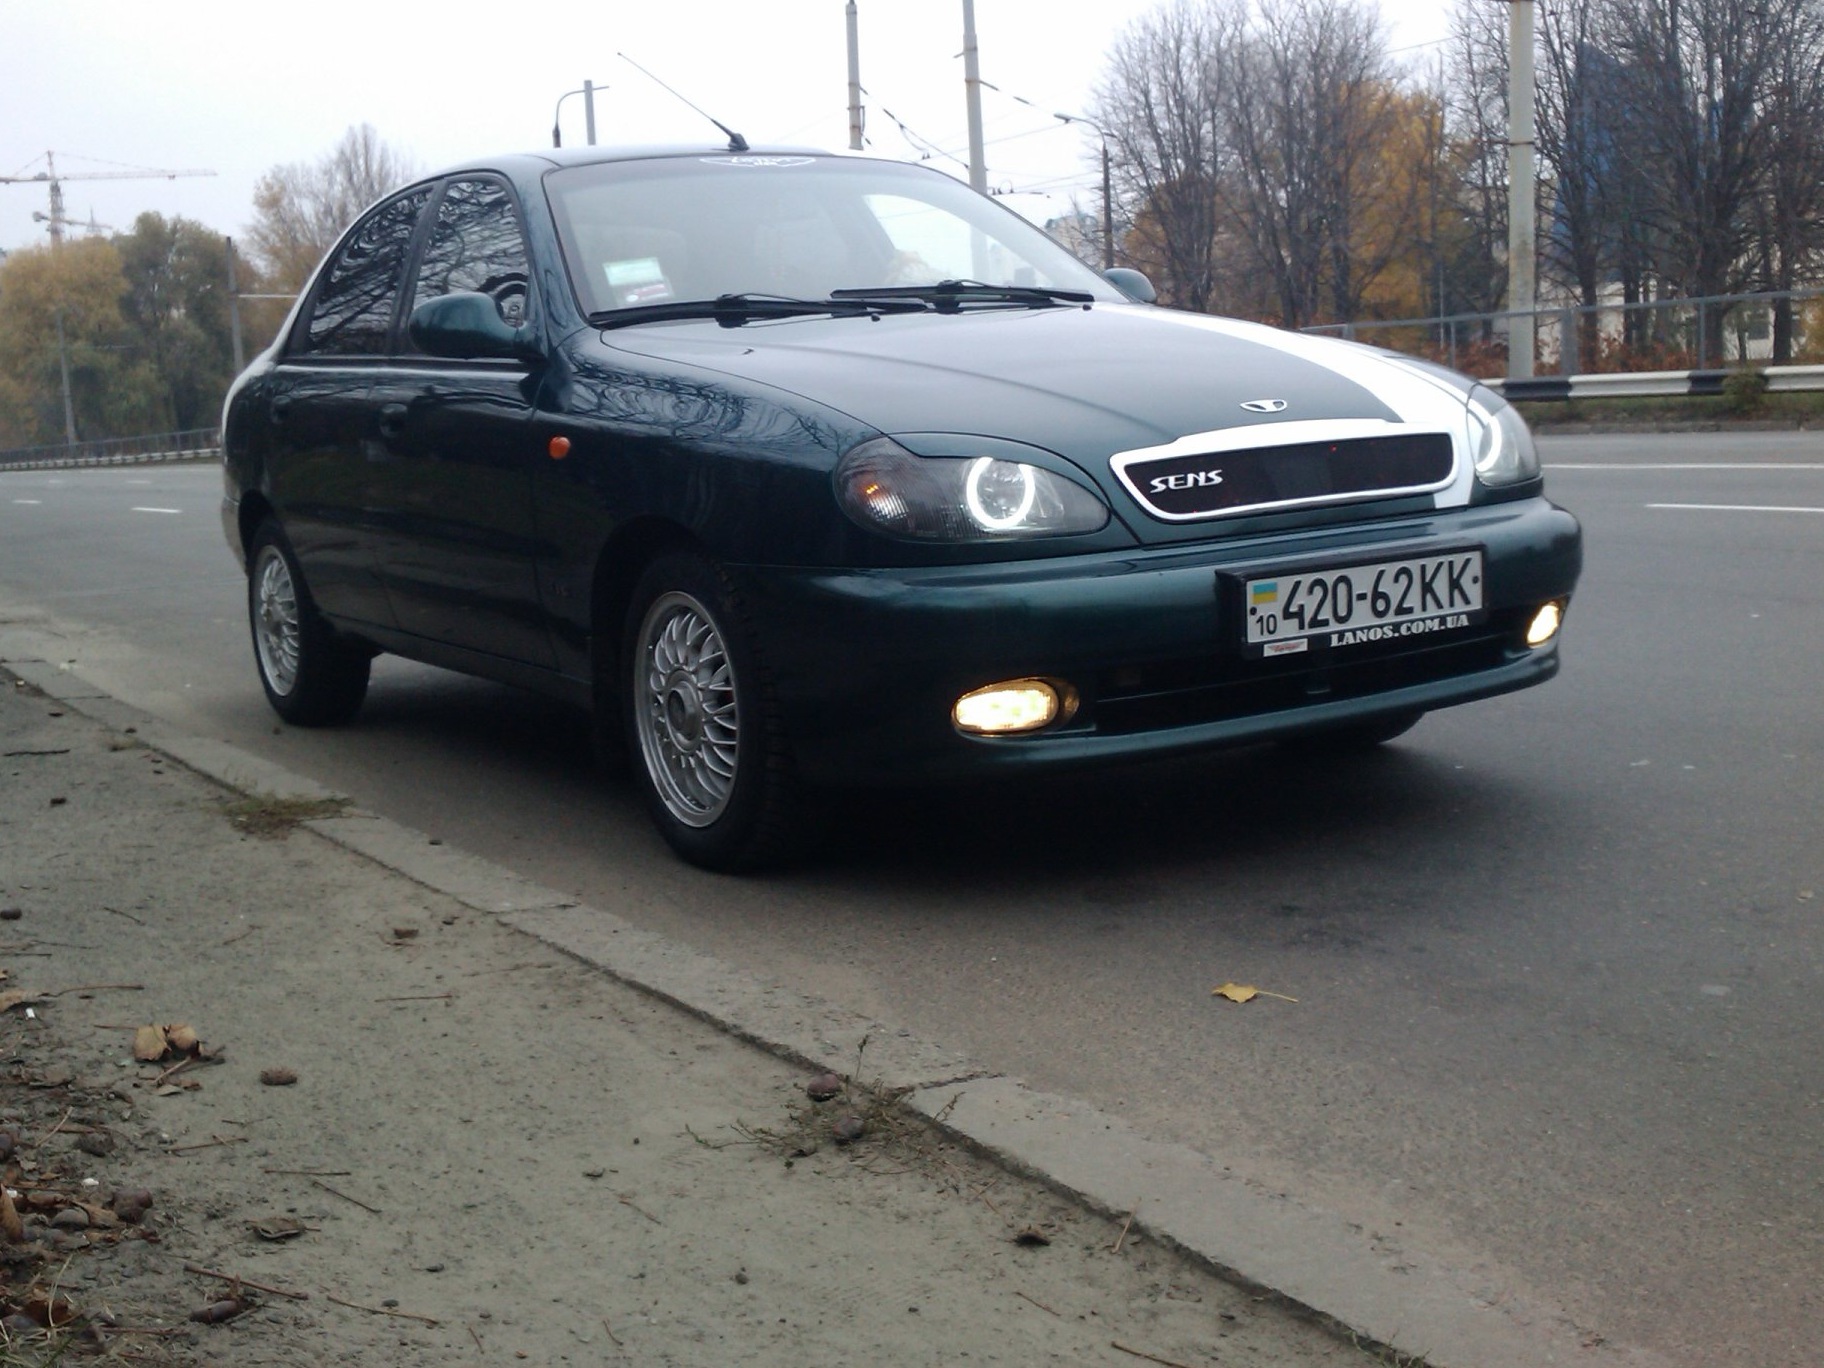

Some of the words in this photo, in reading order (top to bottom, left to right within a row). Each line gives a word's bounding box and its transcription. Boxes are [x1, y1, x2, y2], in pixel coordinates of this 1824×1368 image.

[1150, 469, 1224, 493] SENS
[1282, 557, 1473, 631] 420-62KK
[1256, 613, 1277, 636] 10
[1330, 613, 1470, 647] LANOS.COM.UA
